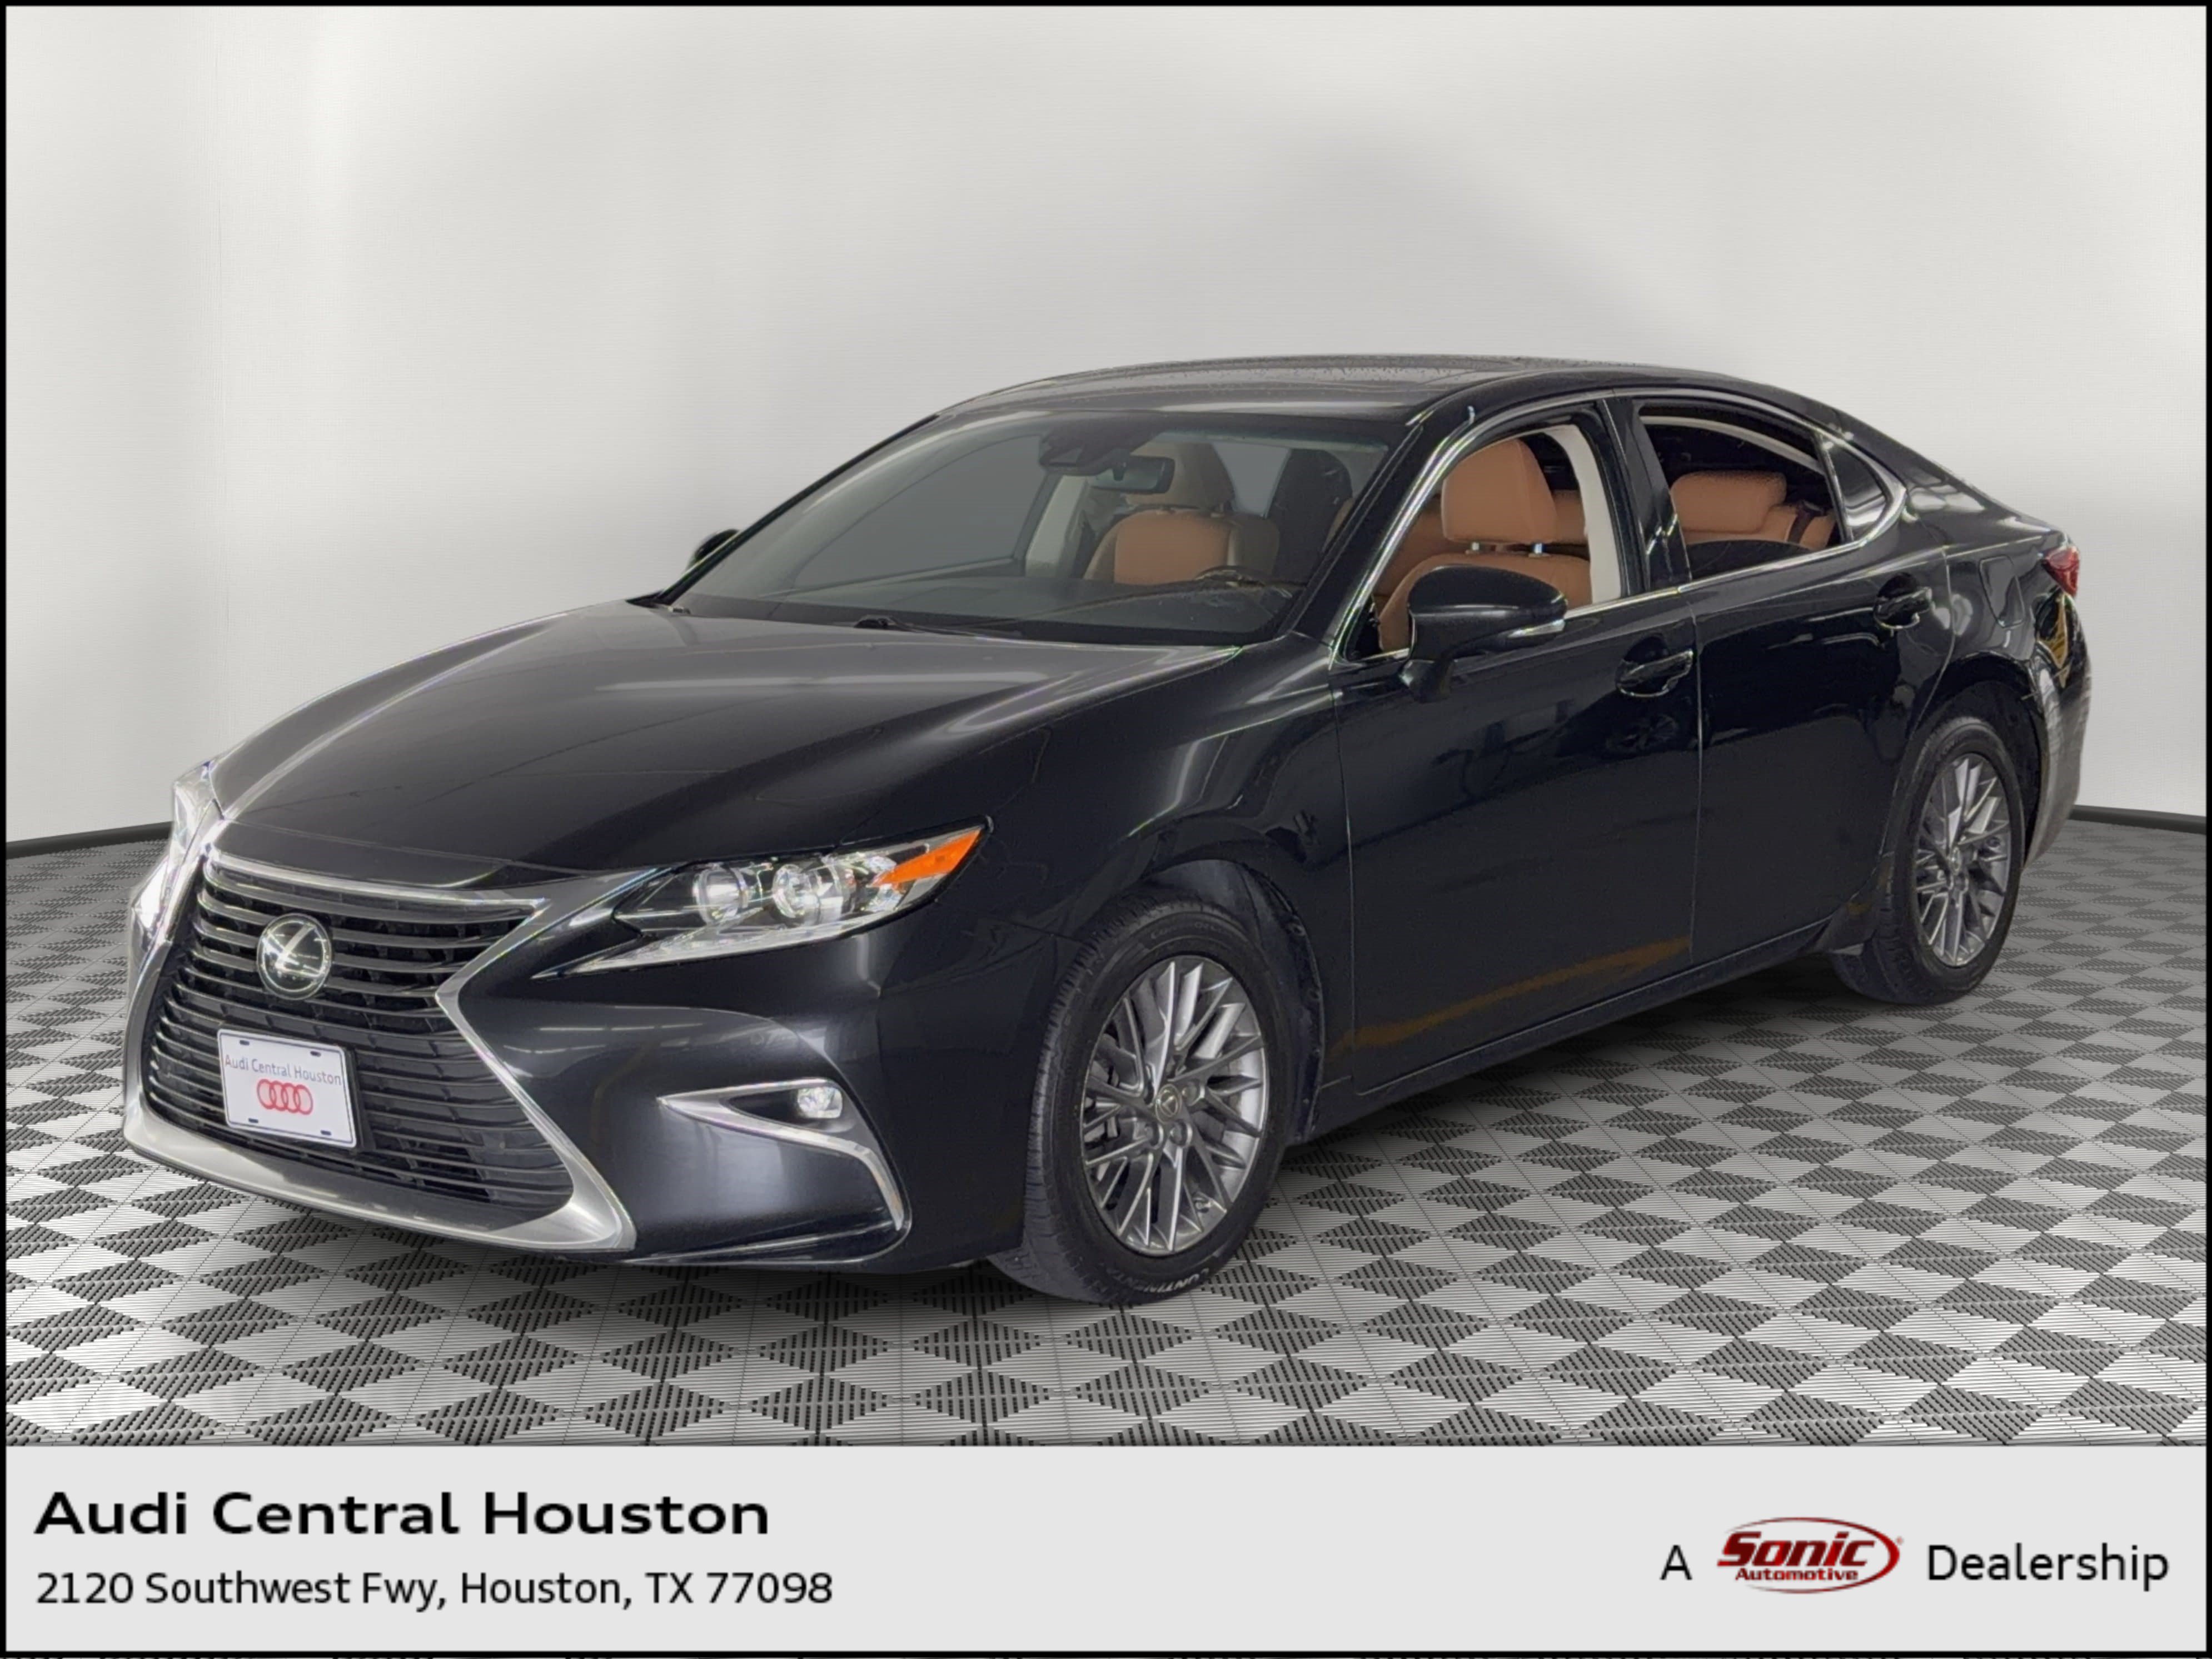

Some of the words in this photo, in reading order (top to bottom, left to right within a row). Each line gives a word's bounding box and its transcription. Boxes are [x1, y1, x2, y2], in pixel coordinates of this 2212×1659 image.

[225, 1054, 249, 1071] Audi
[251, 1058, 292, 1078] Central
[293, 1065, 342, 1085] Houston
